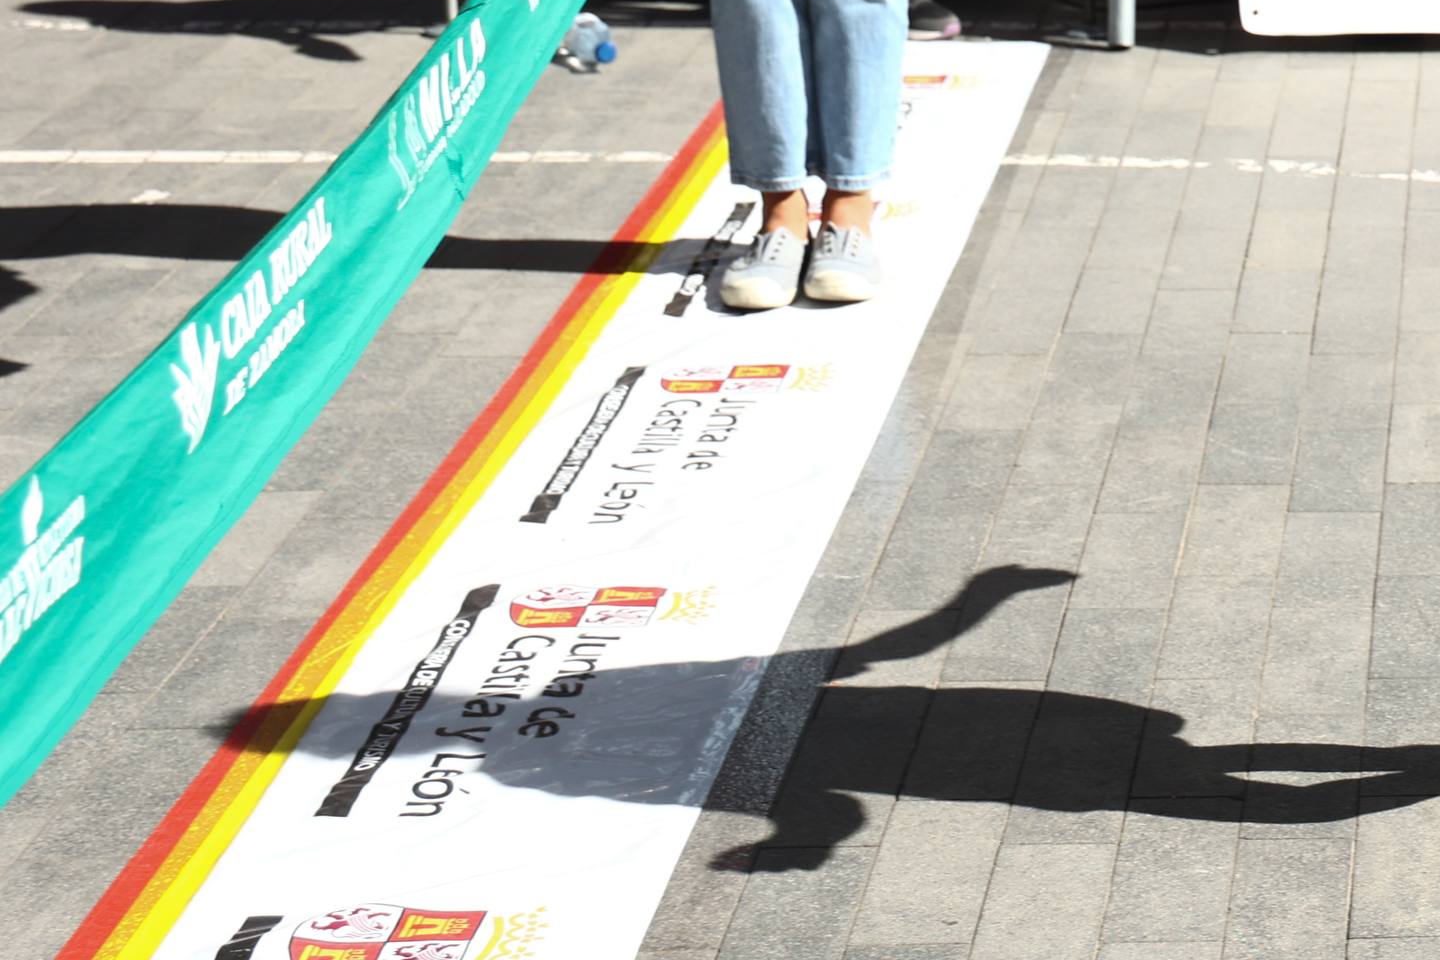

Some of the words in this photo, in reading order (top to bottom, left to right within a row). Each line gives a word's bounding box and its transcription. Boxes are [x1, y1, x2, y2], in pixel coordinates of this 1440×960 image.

[696, 397, 757, 444] Junta
[681, 449, 726, 472] de
[541, 632, 621, 698] Junta
[434, 725, 493, 744] y
[517, 706, 576, 739] de
